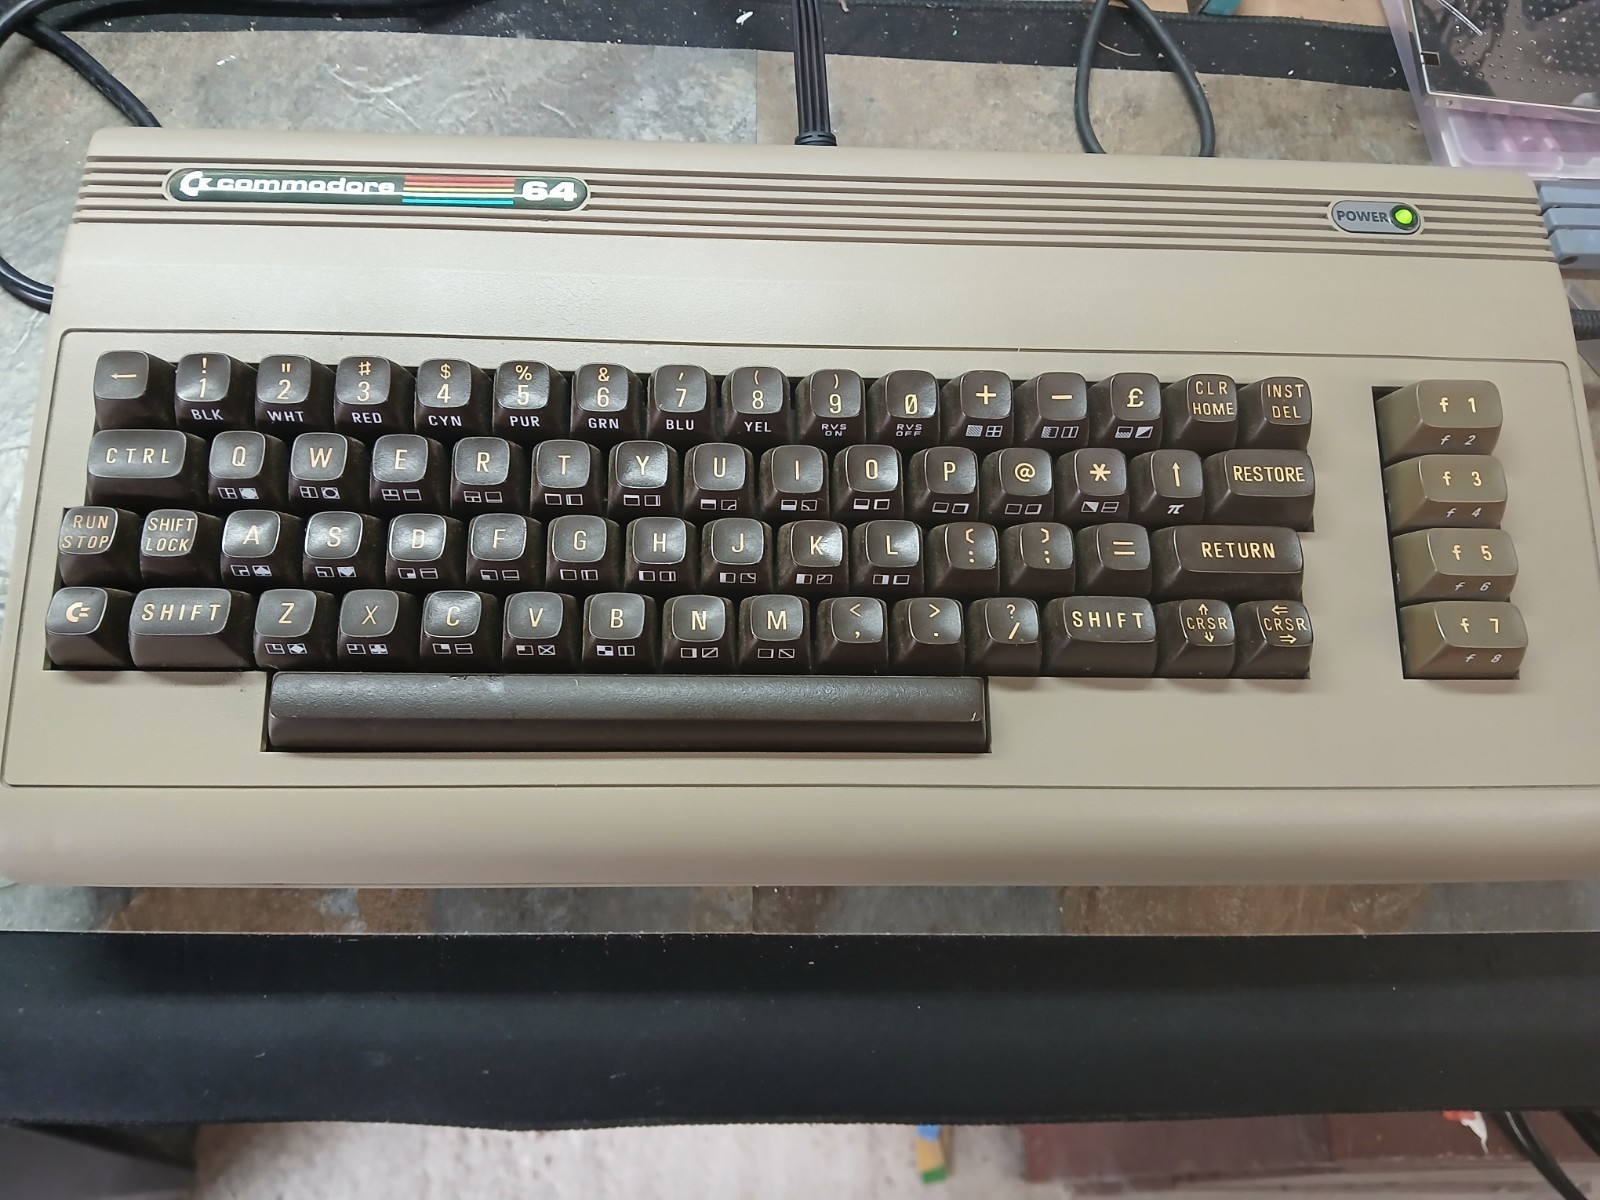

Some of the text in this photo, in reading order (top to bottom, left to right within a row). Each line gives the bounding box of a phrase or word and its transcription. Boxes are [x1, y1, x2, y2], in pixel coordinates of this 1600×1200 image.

[217, 176, 577, 202] commodore 64
[1337, 210, 1389, 223] POWER
[202, 358, 208, 373] !
[358, 362, 371, 376] #
[440, 364, 451, 380] $
[515, 365, 532, 380] %
[598, 368, 609, 381] &
[754, 370, 759, 385] (
[834, 374, 839, 389] )
[199, 378, 207, 398] 1
[277, 380, 292, 399] 2
[357, 382, 370, 401] 3
[437, 384, 451, 403] 4
[518, 385, 529, 404] 5
[976, 385, 996, 404] +
[1195, 382, 1228, 395] CLR
[1267, 384, 1304, 398] INST
[597, 388, 609, 407] 6
[676, 389, 687, 408] 7
[752, 390, 764, 410] 8
[829, 394, 841, 413] 9
[1126, 388, 1144, 408] £
[191, 409, 224, 420] BLK
[267, 411, 304, 422] WHT
[1193, 402, 1234, 415] HOME
[1272, 406, 1301, 419] DEL
[352, 412, 382, 424] RED
[428, 416, 462, 427] CYN
[510, 416, 540, 427] PUR
[588, 418, 619, 429] GRN
[666, 419, 694, 430] BLU
[744, 422, 772, 432] YEL
[106, 448, 170, 464] CTRL
[232, 446, 245, 467] Q
[310, 448, 332, 468] W
[394, 450, 407, 470] E
[476, 452, 490, 472] R
[558, 455, 570, 475] T
[636, 456, 650, 475] Y
[713, 458, 726, 477] U
[795, 460, 799, 480] I
[865, 459, 878, 479] O
[944, 462, 956, 481] P
[1015, 463, 1036, 482] @
[1233, 466, 1305, 482] RESTORE
[73, 516, 108, 528] RUN
[148, 518, 194, 532] SHIFT
[62, 536, 108, 549] STOP
[243, 525, 260, 545] A
[327, 527, 343, 547] S
[411, 529, 425, 548] D
[493, 529, 506, 548] F
[573, 530, 586, 550] G
[653, 533, 667, 552] H
[731, 533, 744, 552] J
[146, 538, 189, 551] LOCK
[810, 536, 824, 555] K
[886, 535, 898, 555] L
[1113, 541, 1135, 555] =
[1202, 542, 1275, 559] RETURN
[968, 550, 975, 563] :
[1044, 550, 1050, 563] ;
[141, 604, 221, 621] SHIFT
[278, 602, 295, 624] Z
[362, 606, 379, 624] X
[446, 606, 460, 626] C
[529, 608, 543, 627] V
[610, 608, 624, 628] B
[850, 604, 861, 617] <
[928, 604, 940, 617] >
[1007, 604, 1016, 619] ?
[692, 610, 706, 630] N
[768, 610, 787, 630] M
[1072, 611, 1143, 629] SHIFT
[1186, 617, 1228, 630] CRSR
[1264, 618, 1309, 631] CRSR
[1008, 622, 1020, 639] /
